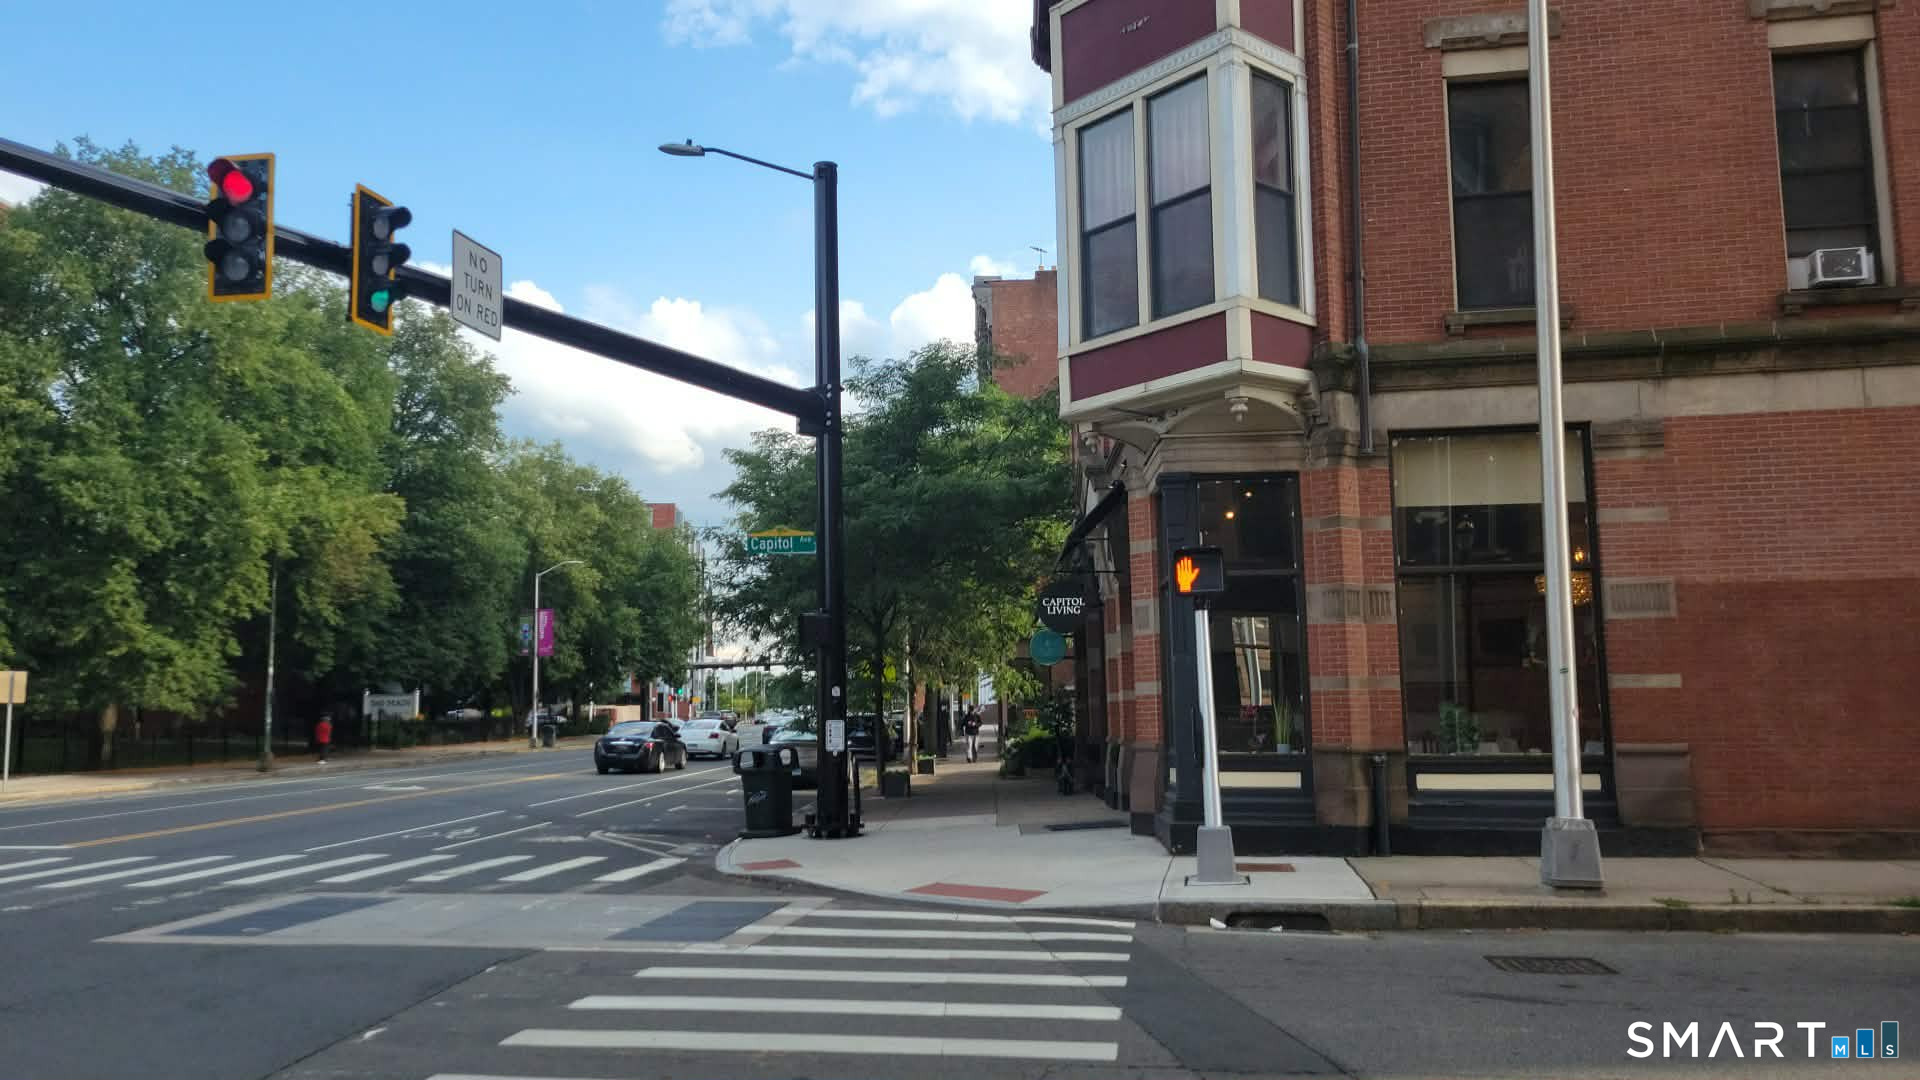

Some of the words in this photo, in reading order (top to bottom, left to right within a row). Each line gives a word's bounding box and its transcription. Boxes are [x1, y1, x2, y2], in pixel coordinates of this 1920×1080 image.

[469, 250, 488, 273] NO
[464, 271, 493, 301] TURN
[456, 294, 471, 314] ON
[476, 303, 498, 327] RED
[750, 536, 793, 553] Capitol
[1042, 597, 1086, 607] CAPITOL
[1047, 605, 1081, 615] LIVING
